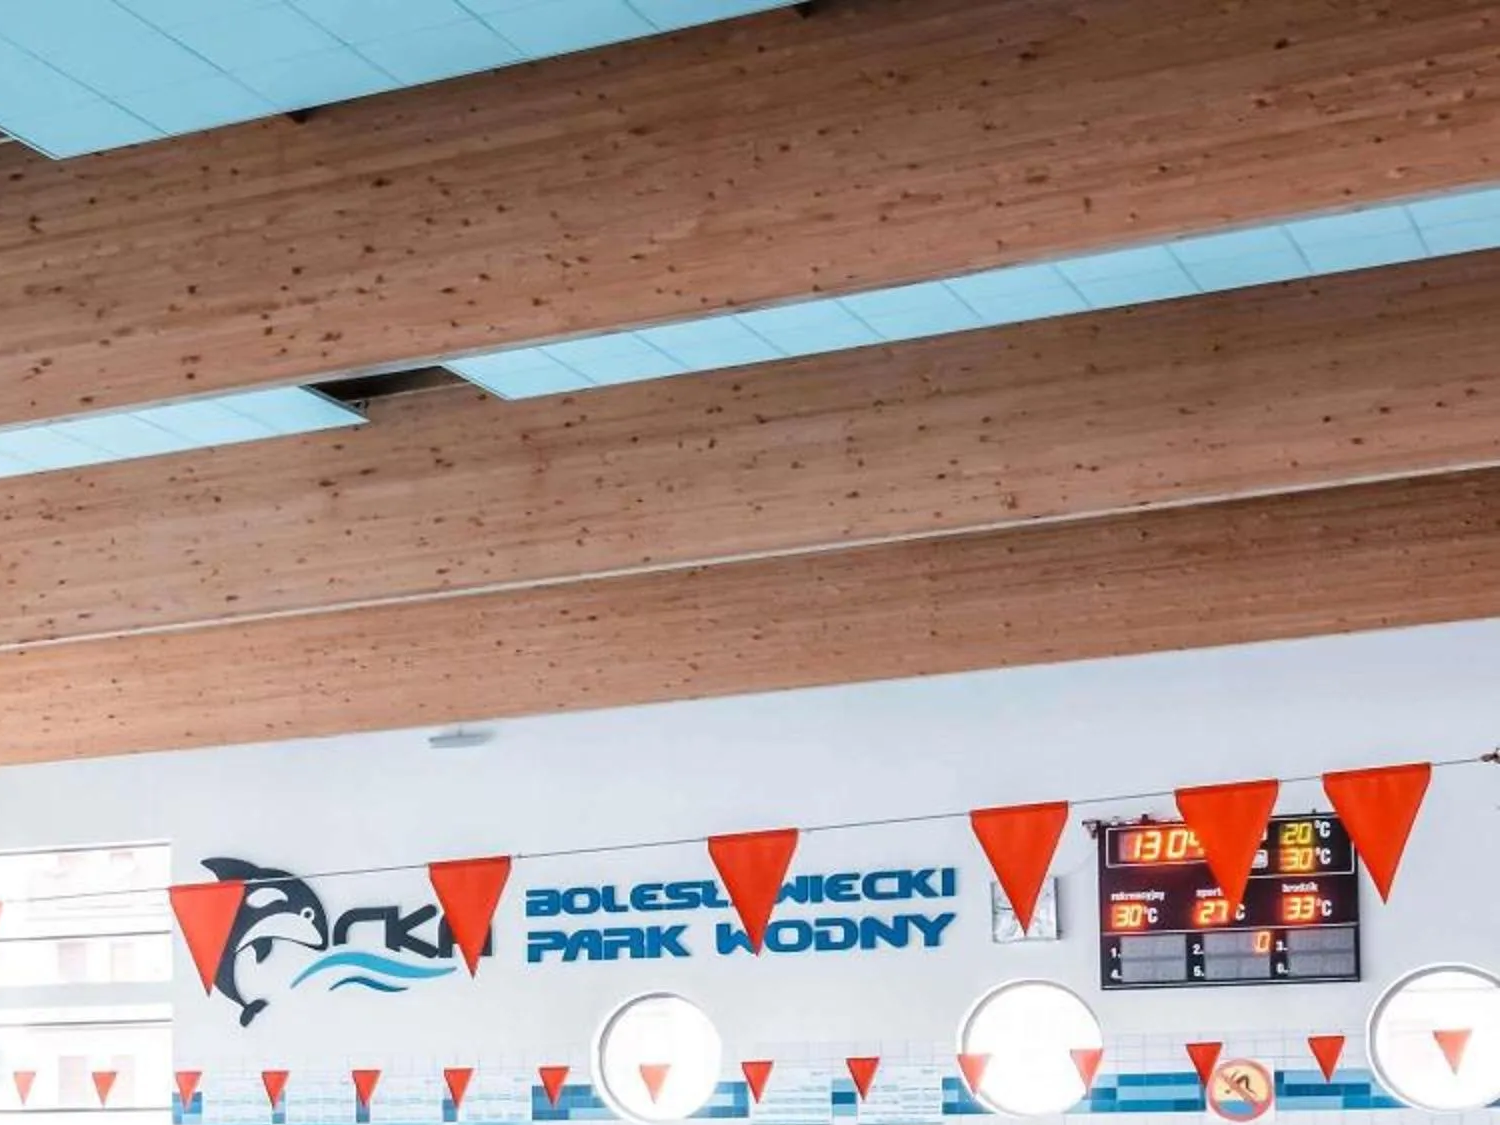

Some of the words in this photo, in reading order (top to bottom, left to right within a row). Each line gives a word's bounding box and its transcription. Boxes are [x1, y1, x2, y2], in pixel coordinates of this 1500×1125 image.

[525, 867, 957, 917] BOLESŁWIECKI
[527, 925, 691, 963] PARK
[716, 913, 957, 956] WODNY
